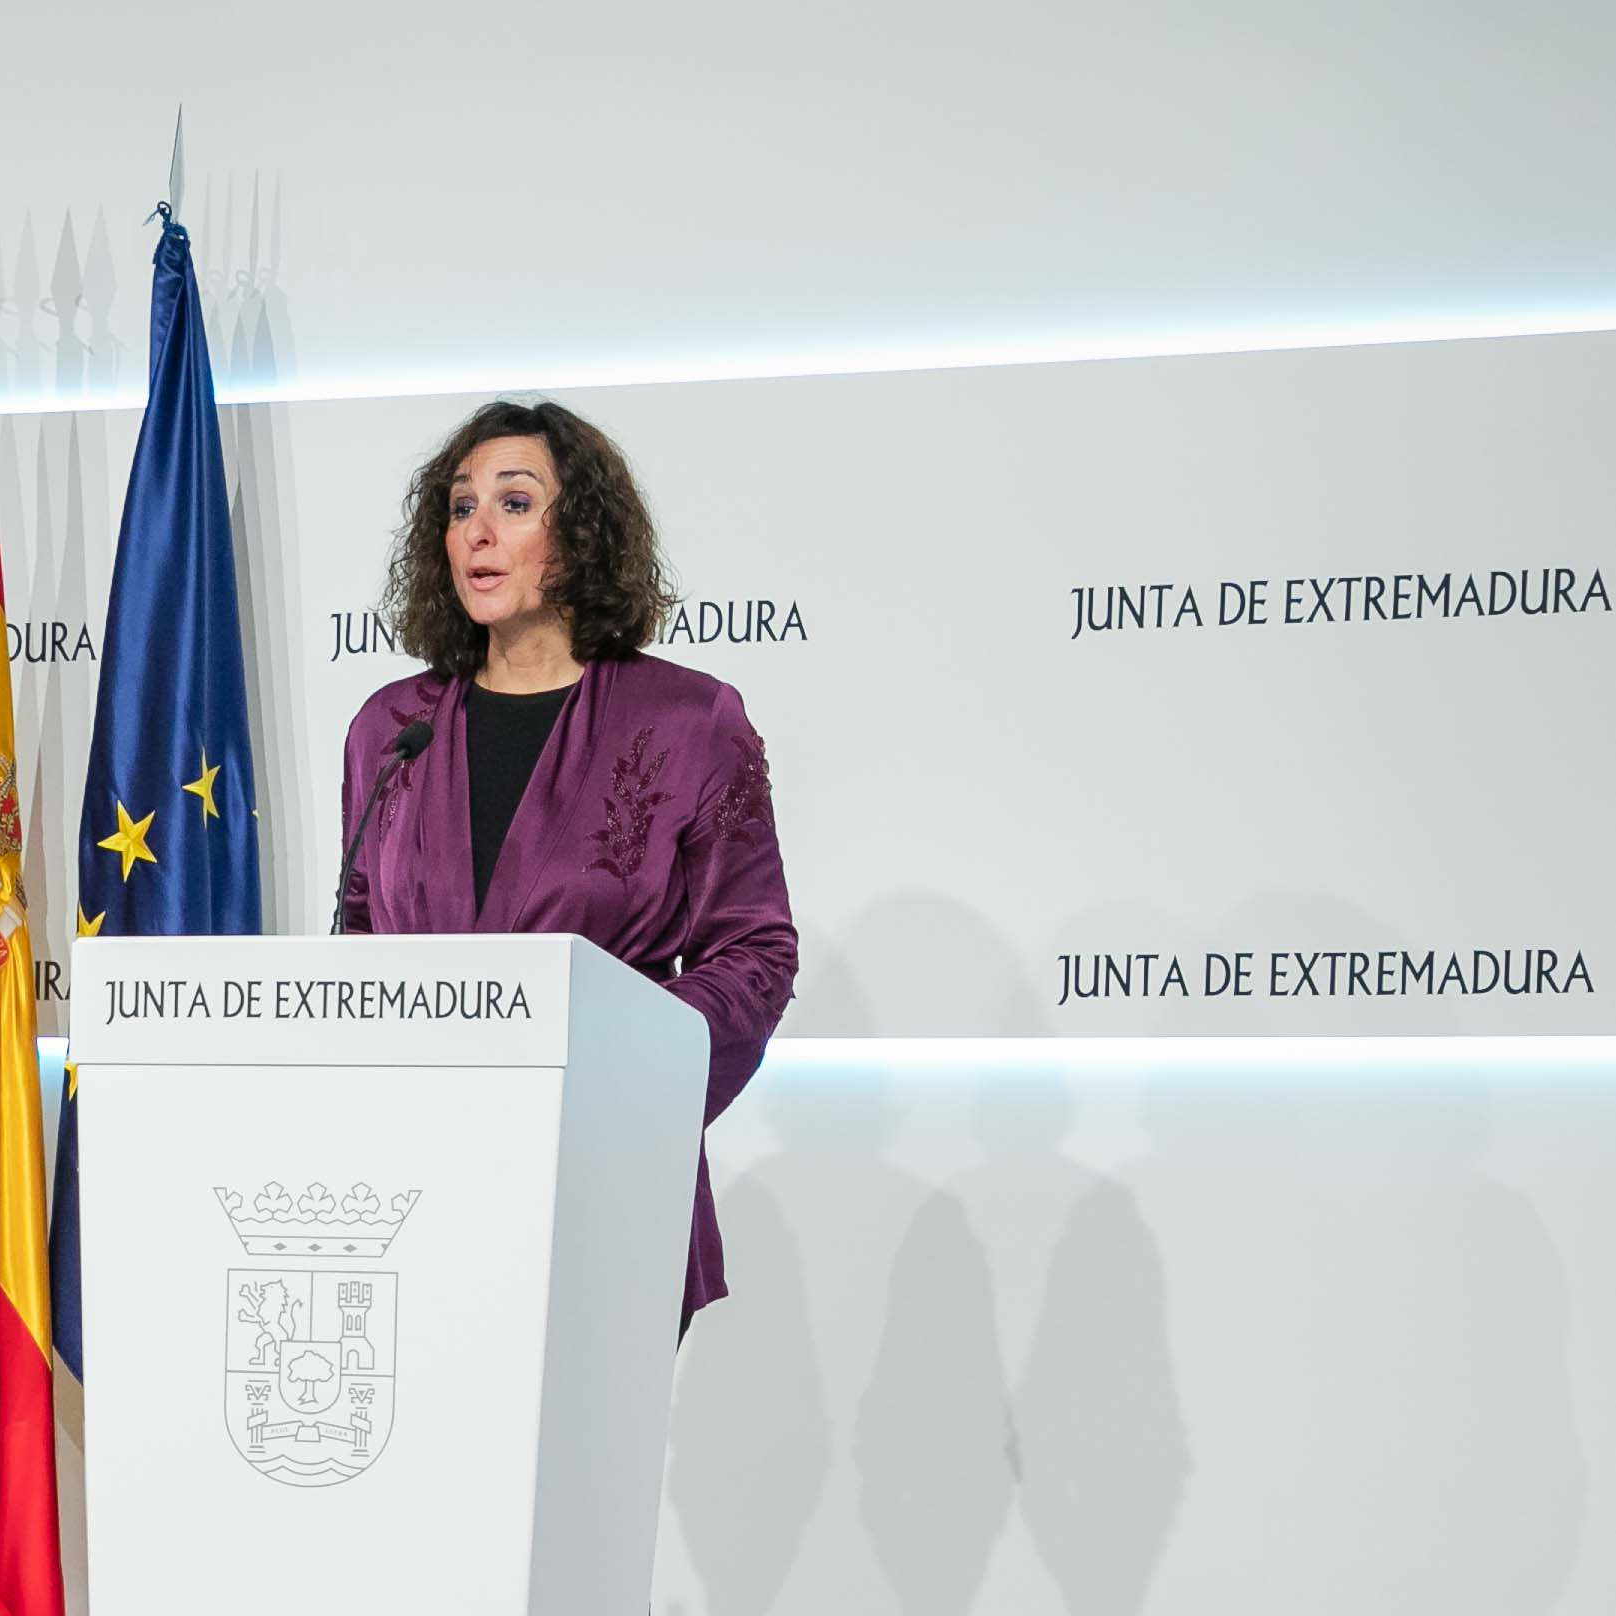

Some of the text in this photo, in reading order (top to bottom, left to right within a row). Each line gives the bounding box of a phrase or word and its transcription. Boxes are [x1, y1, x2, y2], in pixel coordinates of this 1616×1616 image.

[1070, 568, 1614, 640] JUNTA DE EXTREMADURA
[330, 611, 397, 662] JUN
[105, 980, 211, 1025] JUNTA
[223, 981, 262, 1018] DE
[275, 980, 532, 1020] EXTREMADURA
[1057, 949, 1596, 1006] JUNTA DE EXTREMADURA
